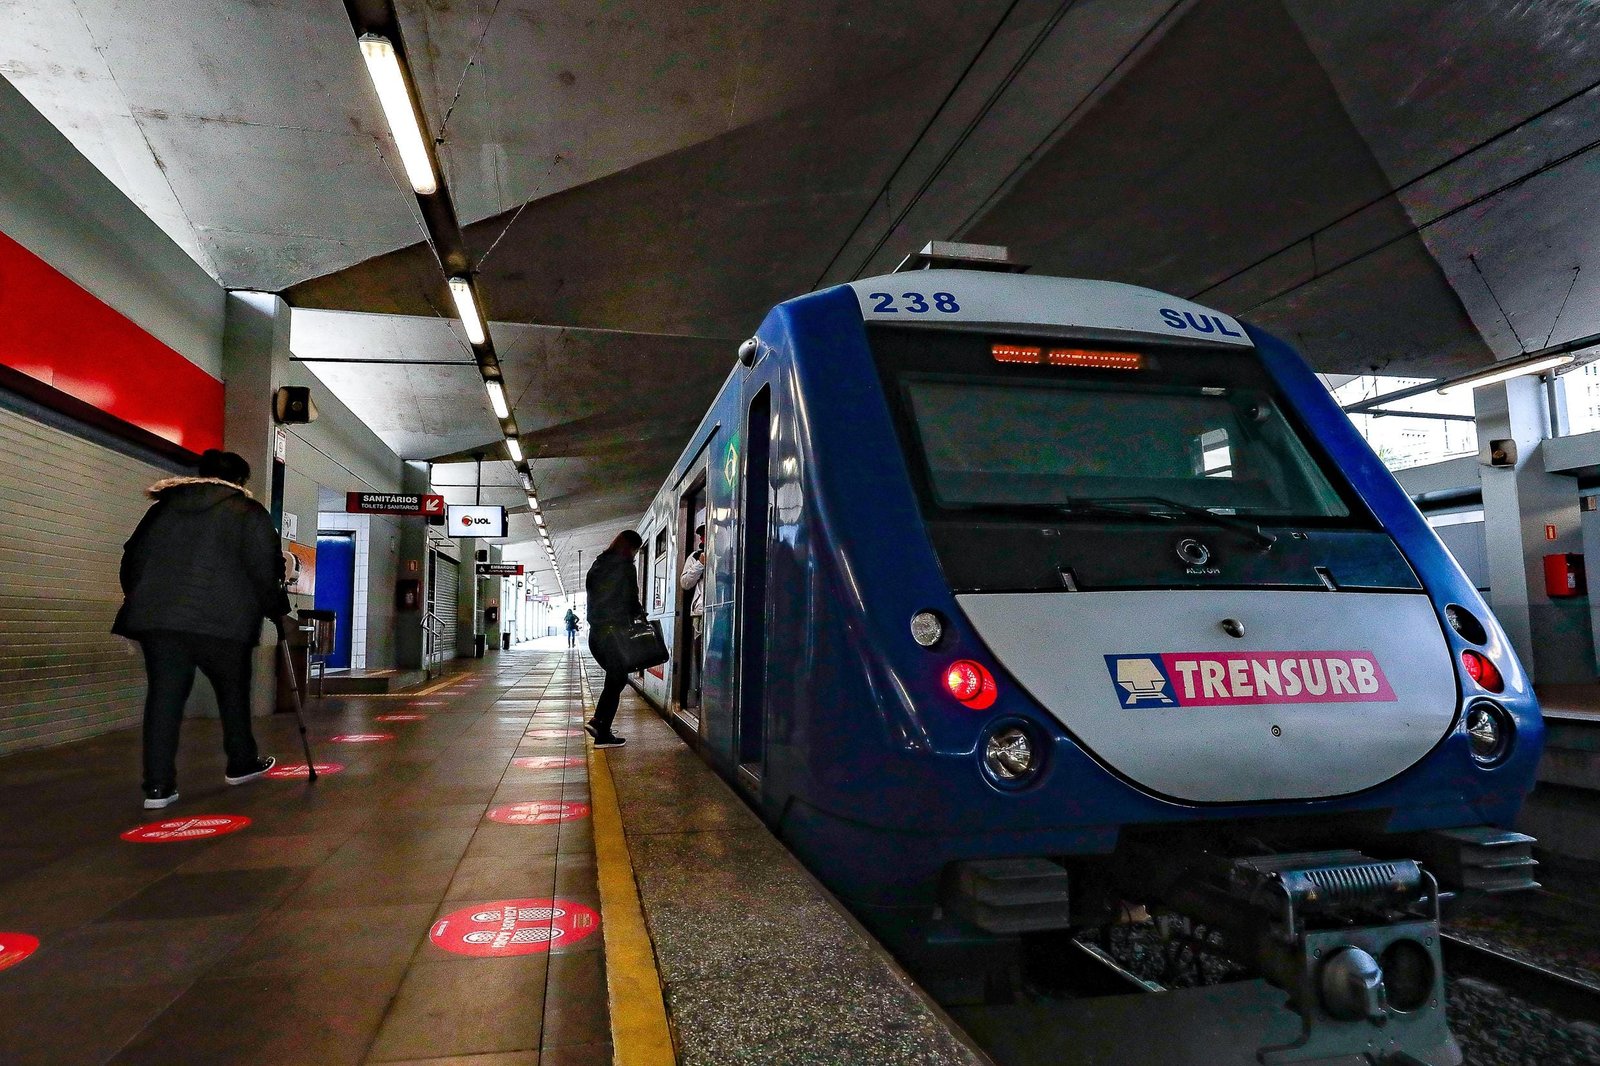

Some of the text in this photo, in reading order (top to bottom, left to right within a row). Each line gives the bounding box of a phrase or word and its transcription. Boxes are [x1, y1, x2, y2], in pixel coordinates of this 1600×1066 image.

[869, 292, 961, 313] 238
[1159, 307, 1242, 338] SUL
[363, 494, 418, 504] SANITÁRIOS
[1175, 658, 1380, 699] TRENSURB
